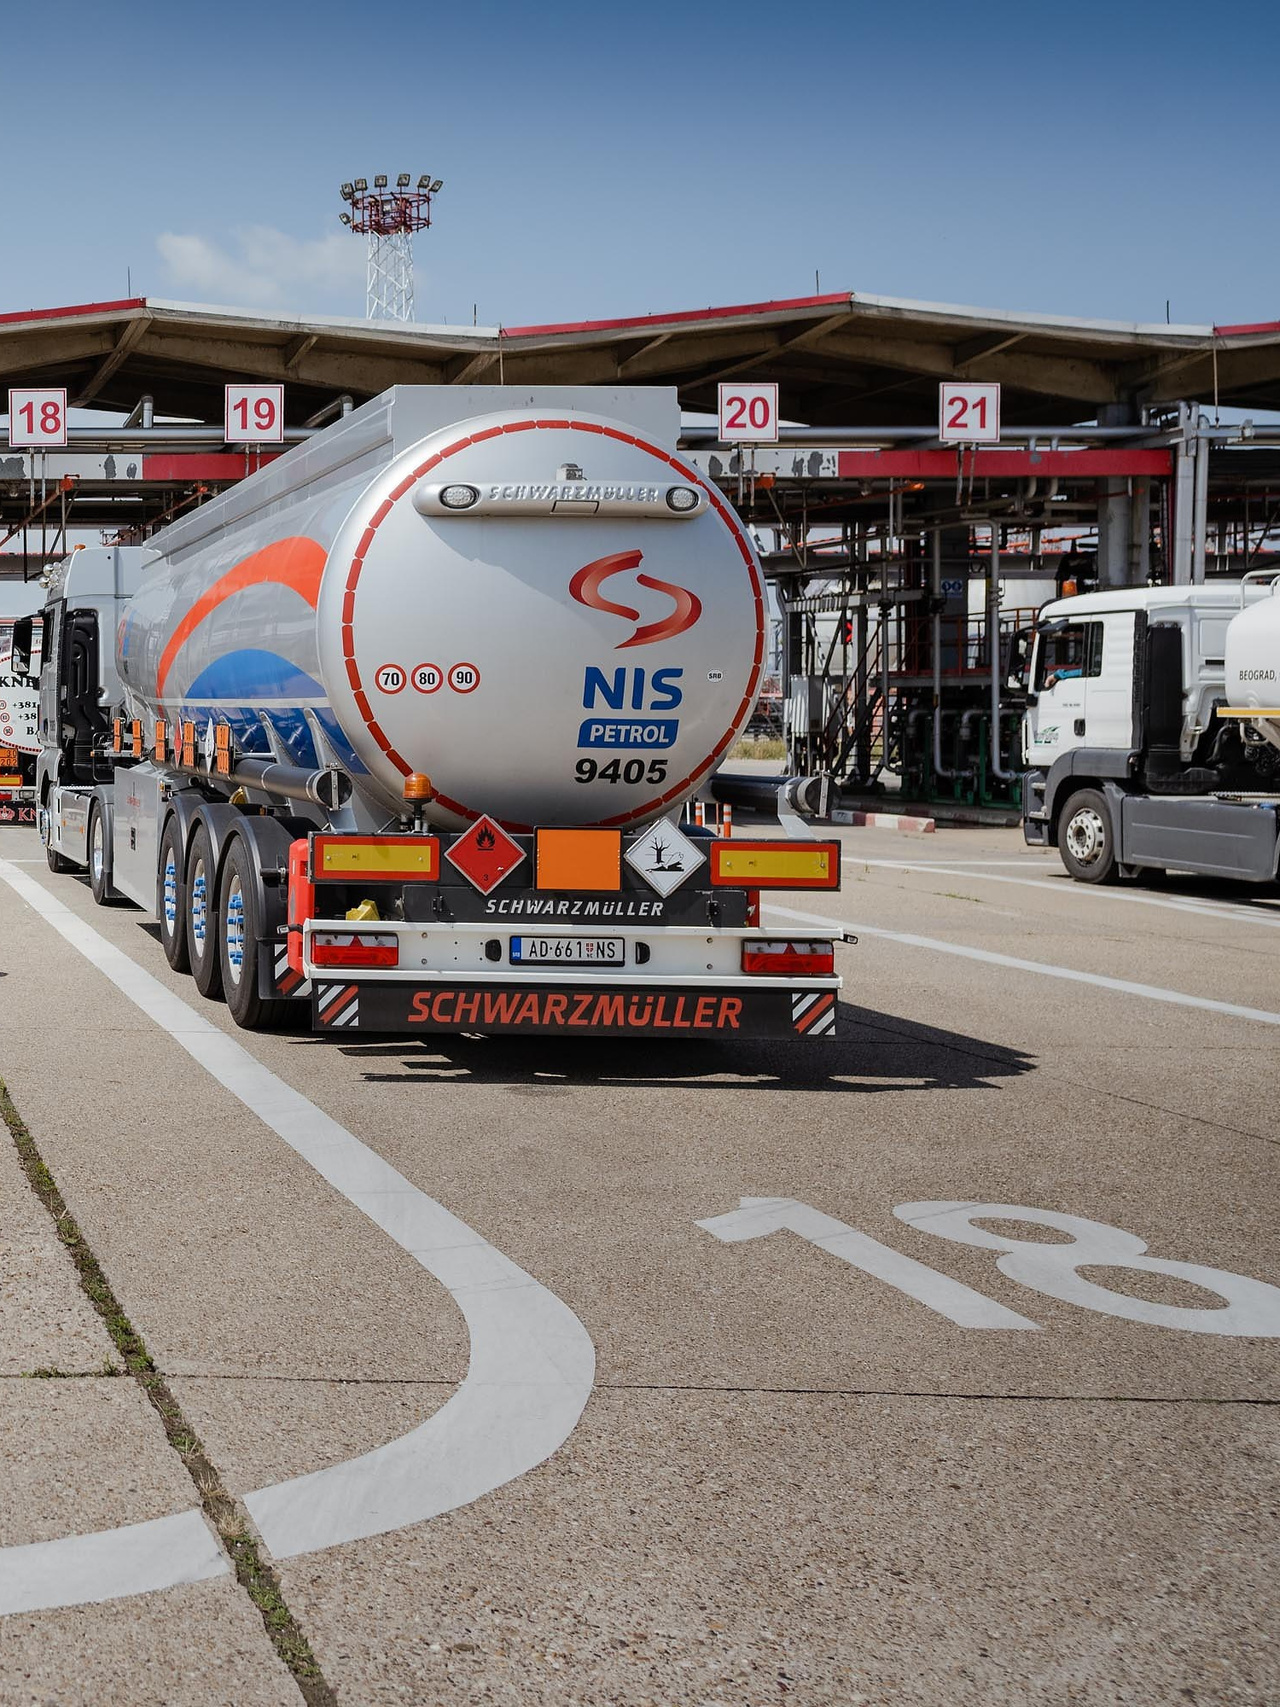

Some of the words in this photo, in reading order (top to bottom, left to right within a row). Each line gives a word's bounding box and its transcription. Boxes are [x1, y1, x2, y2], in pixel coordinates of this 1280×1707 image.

[19, 401, 61, 434] 18
[233, 397, 276, 431] 19
[726, 396, 770, 430] 20
[947, 396, 987, 429] 21
[381, 672, 400, 686] 70
[418, 672, 436, 685] 80
[456, 671, 473, 684] 90
[583, 666, 684, 711] NIS
[18, 712, 37, 721] +38
[589, 724, 669, 743] PETROL
[7, 750, 17, 758] 30
[574, 757, 669, 784] 9405
[18, 807, 37, 821] KN
[485, 899, 664, 916] SCHWARZMÜLLER
[596, 941, 616, 959] NS
[407, 991, 743, 1029] SCHWARZMÜLLER
[694, 1196, 1280, 1337] 18
